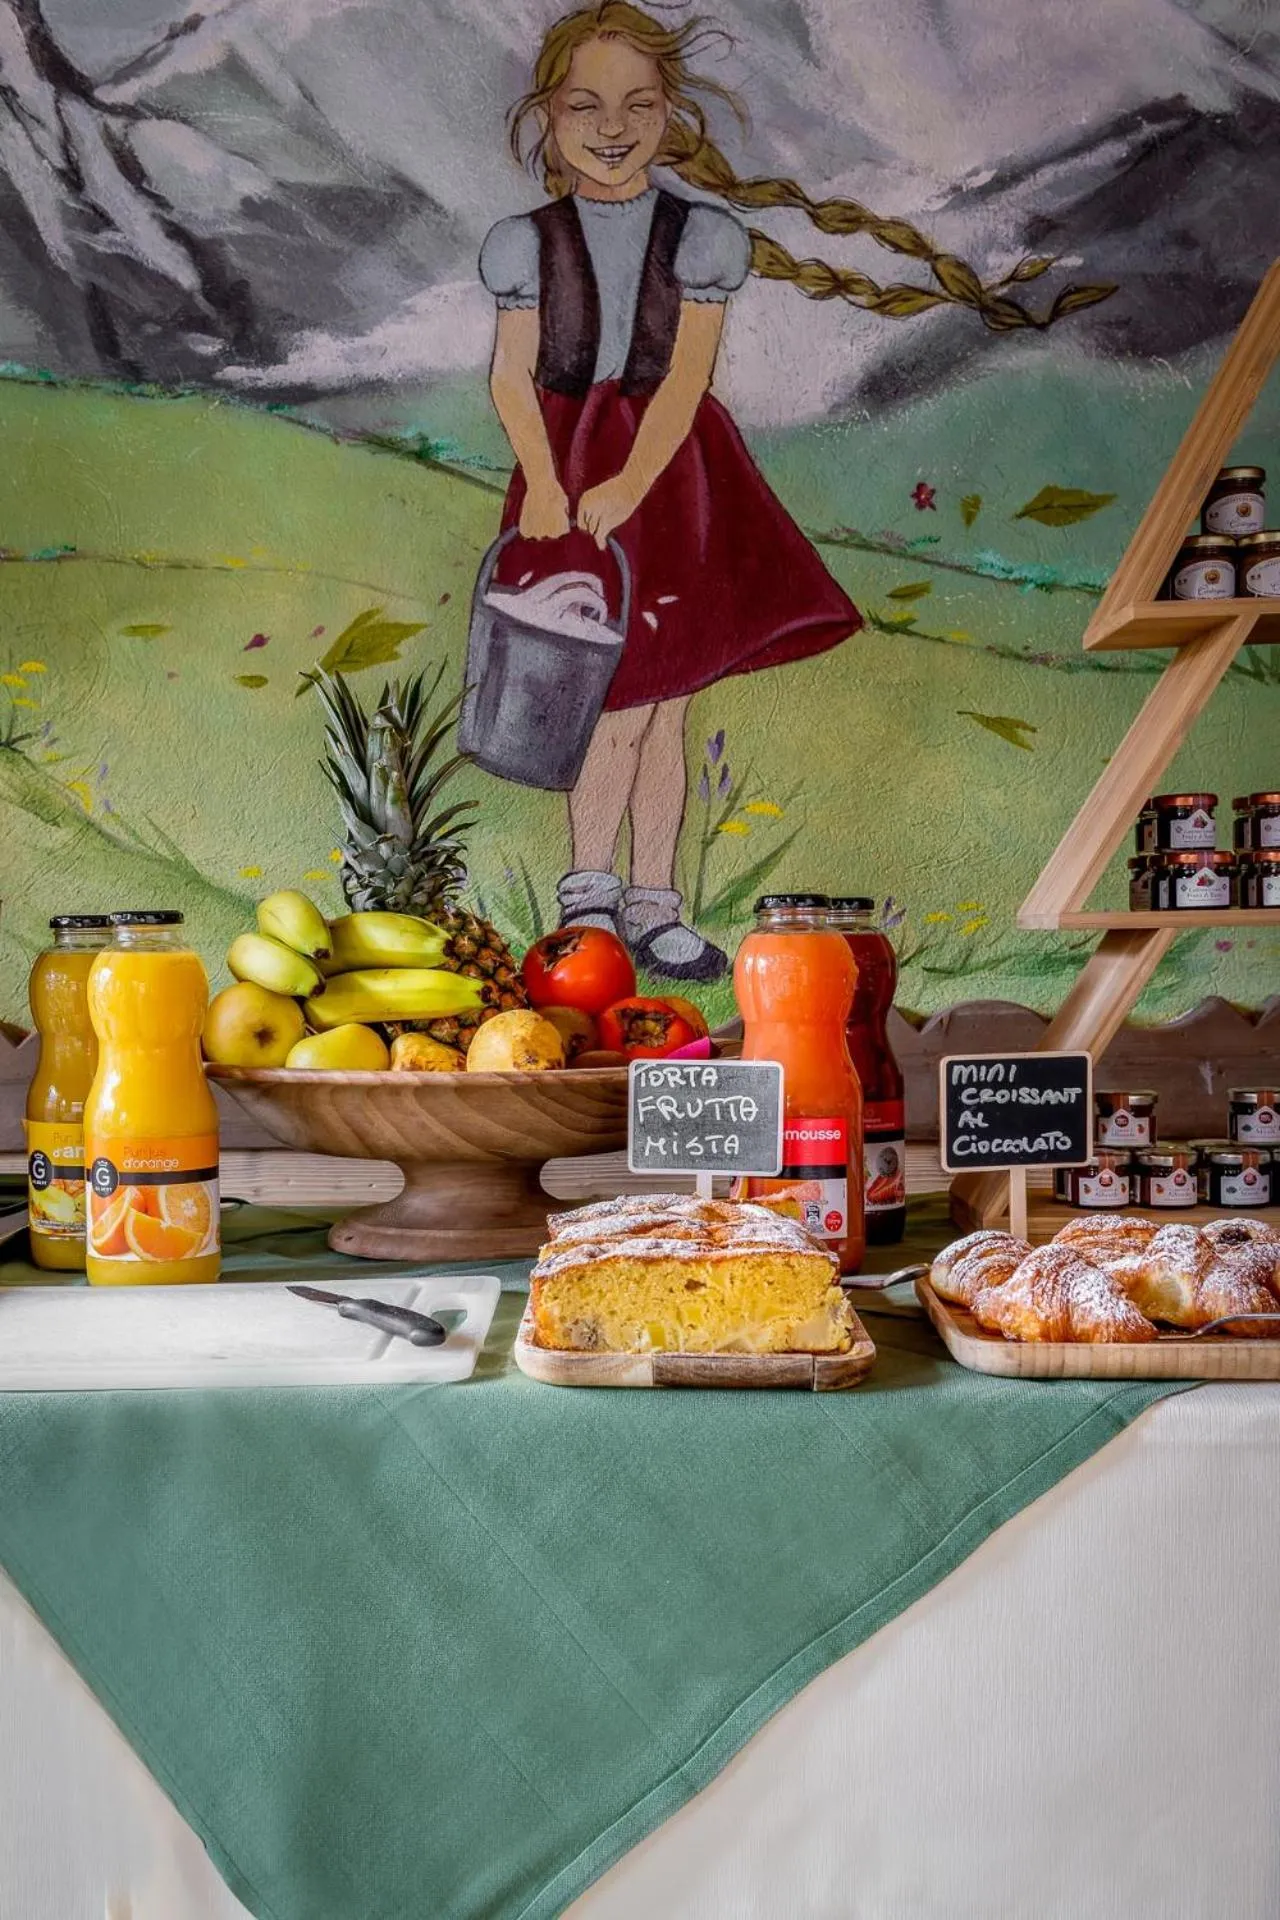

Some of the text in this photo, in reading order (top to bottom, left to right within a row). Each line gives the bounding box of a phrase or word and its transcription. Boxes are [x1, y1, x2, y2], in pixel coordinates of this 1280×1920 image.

[634, 1063, 718, 1087] TORTA
[960, 1086, 1082, 1105] CROISSANT
[637, 1095, 759, 1123] FRUTTA
[95, 1166, 111, 1187] G
